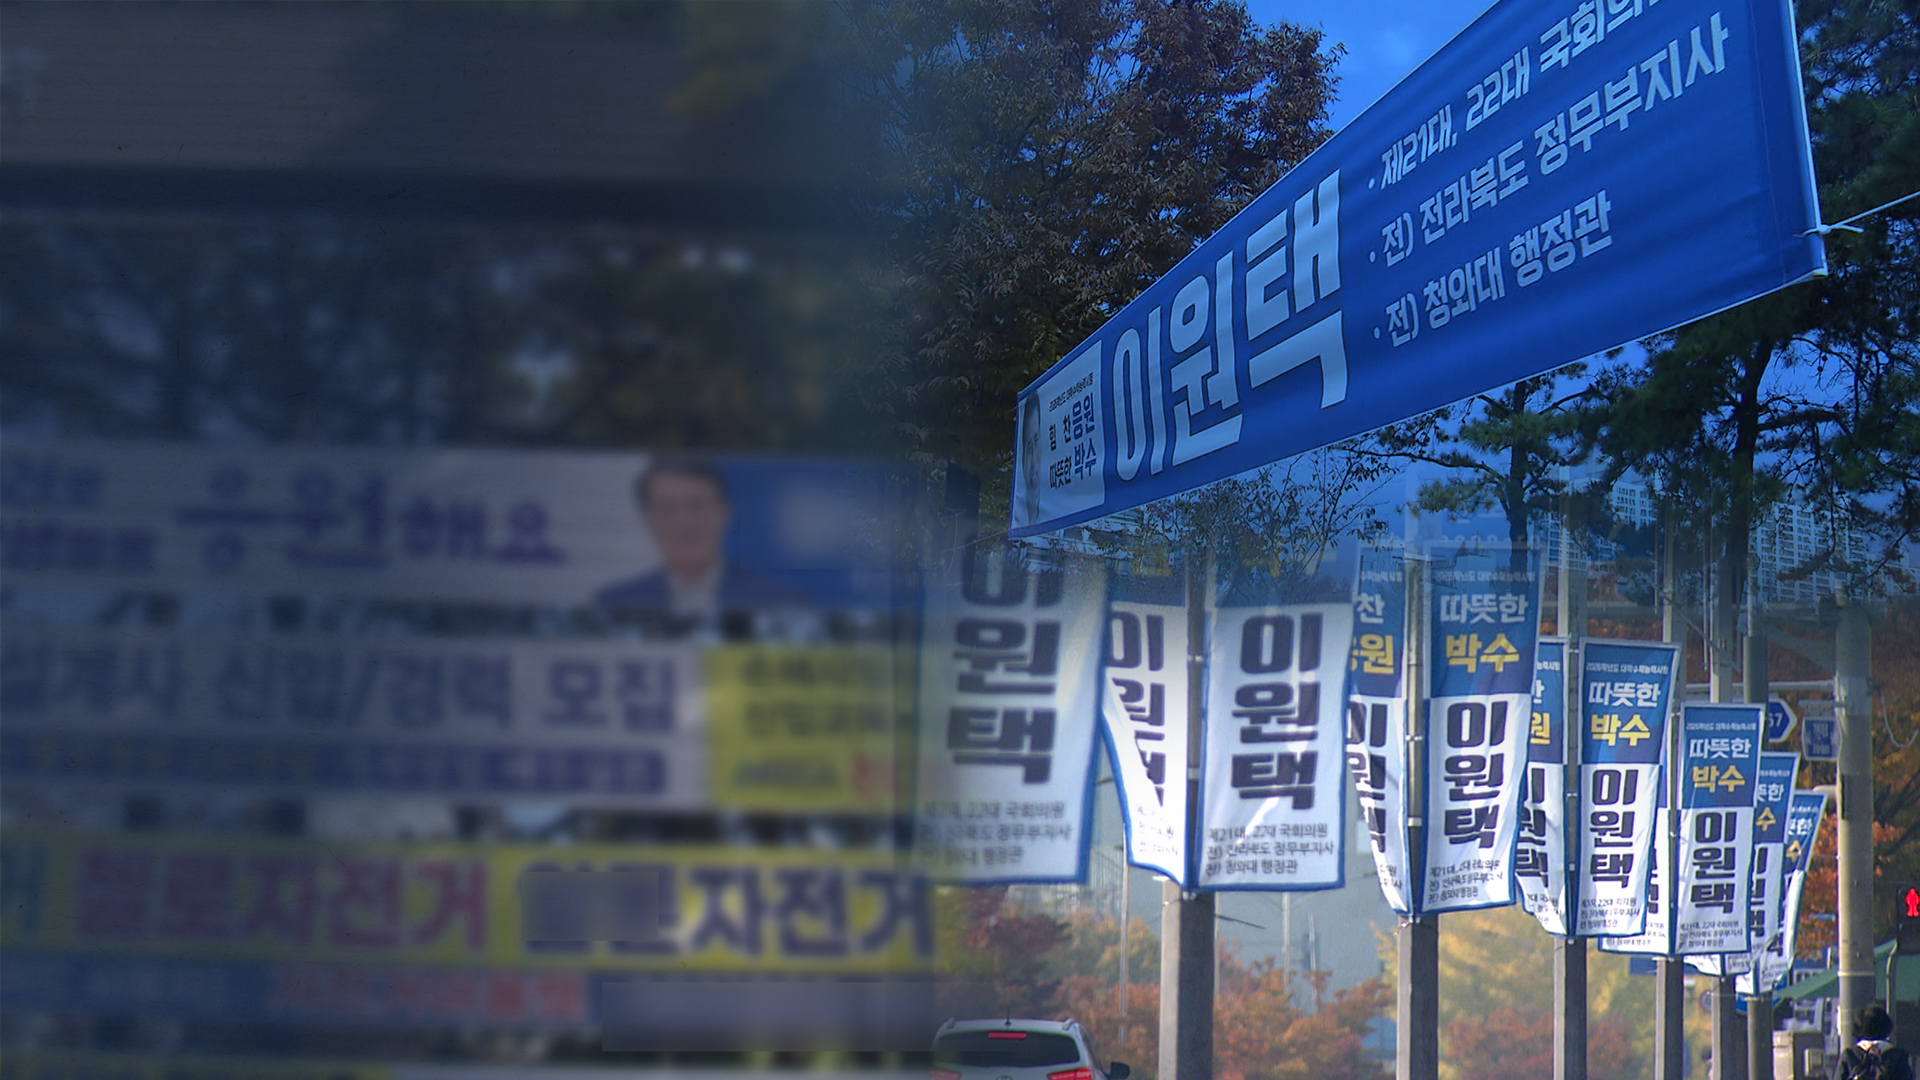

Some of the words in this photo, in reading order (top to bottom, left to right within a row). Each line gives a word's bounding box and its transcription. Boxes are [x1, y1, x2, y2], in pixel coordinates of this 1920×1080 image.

[1381, 104, 1458, 190] 제21대,
[1466, 46, 1531, 131] 22대
[1540, 0, 1668, 74] 국회의
[1382, 212, 1414, 268] 전)
[1420, 140, 1529, 245] 전라북도
[1534, 11, 1730, 175] 정무부지사
[1386, 293, 1419, 348] 전)
[1423, 247, 1505, 330] 청와대
[1509, 189, 1613, 288] 행정관
[1112, 168, 1348, 482] 이원택
[1072, 392, 1095, 440] 응원
[1050, 455, 1072, 489] 따뜻한
[1074, 437, 1097, 480] 박수
[1440, 593, 1529, 624] 따뜻한
[1446, 633, 1520, 673] 박수
[541, 655, 675, 734] 모집
[1230, 613, 1323, 810] 이원택
[1588, 681, 1661, 707] 따뜻한
[1591, 714, 1650, 746] 박수
[1689, 738, 1751, 759] 따뜻한
[1443, 700, 1510, 849] 이원택
[1692, 765, 1745, 793] 박수
[1273, 841, 1335, 856] 정무부지사
[1279, 823, 1328, 838] 국회의원
[1589, 769, 1639, 888] 이원택
[1261, 859, 1299, 875] 행정관
[1690, 811, 1737, 914] 이원택
